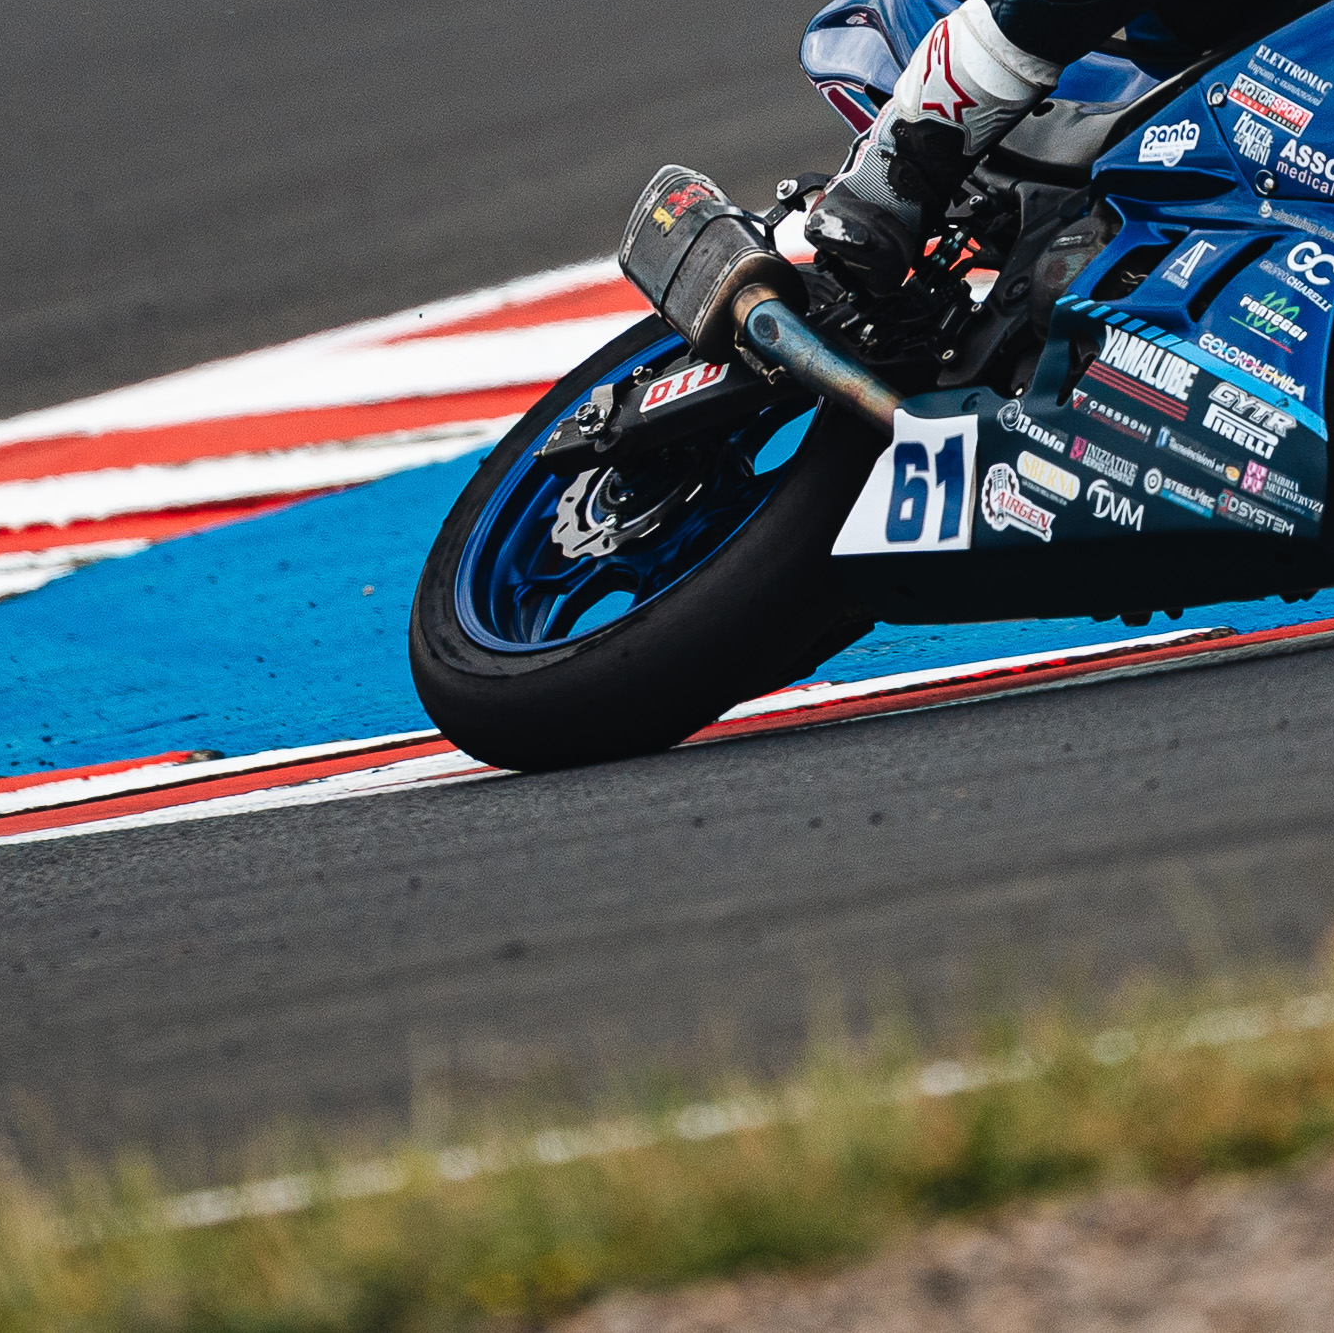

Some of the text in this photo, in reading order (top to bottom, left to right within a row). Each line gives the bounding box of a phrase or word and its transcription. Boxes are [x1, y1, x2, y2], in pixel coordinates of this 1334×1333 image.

[1255, 44, 1333, 94] ELETTROMAC
[1234, 77, 1310, 127] MOTORSPORT
[1144, 124, 1196, 150] panta
[1239, 137, 1271, 166] NANI
[1239, 294, 1308, 342] PONTEGGI
[1099, 324, 1200, 402] YAMALUBE
[1202, 403, 1279, 460] PIRELLI
[1208, 382, 1297, 438] GYTR
[1023, 453, 1075, 500] SBERNA
[1086, 442, 1139, 477] INIZIATIVE
[1267, 471, 1300, 492] UMBRIA
[885, 433, 965, 543] 61
[995, 492, 1051, 529] AIRGEN
